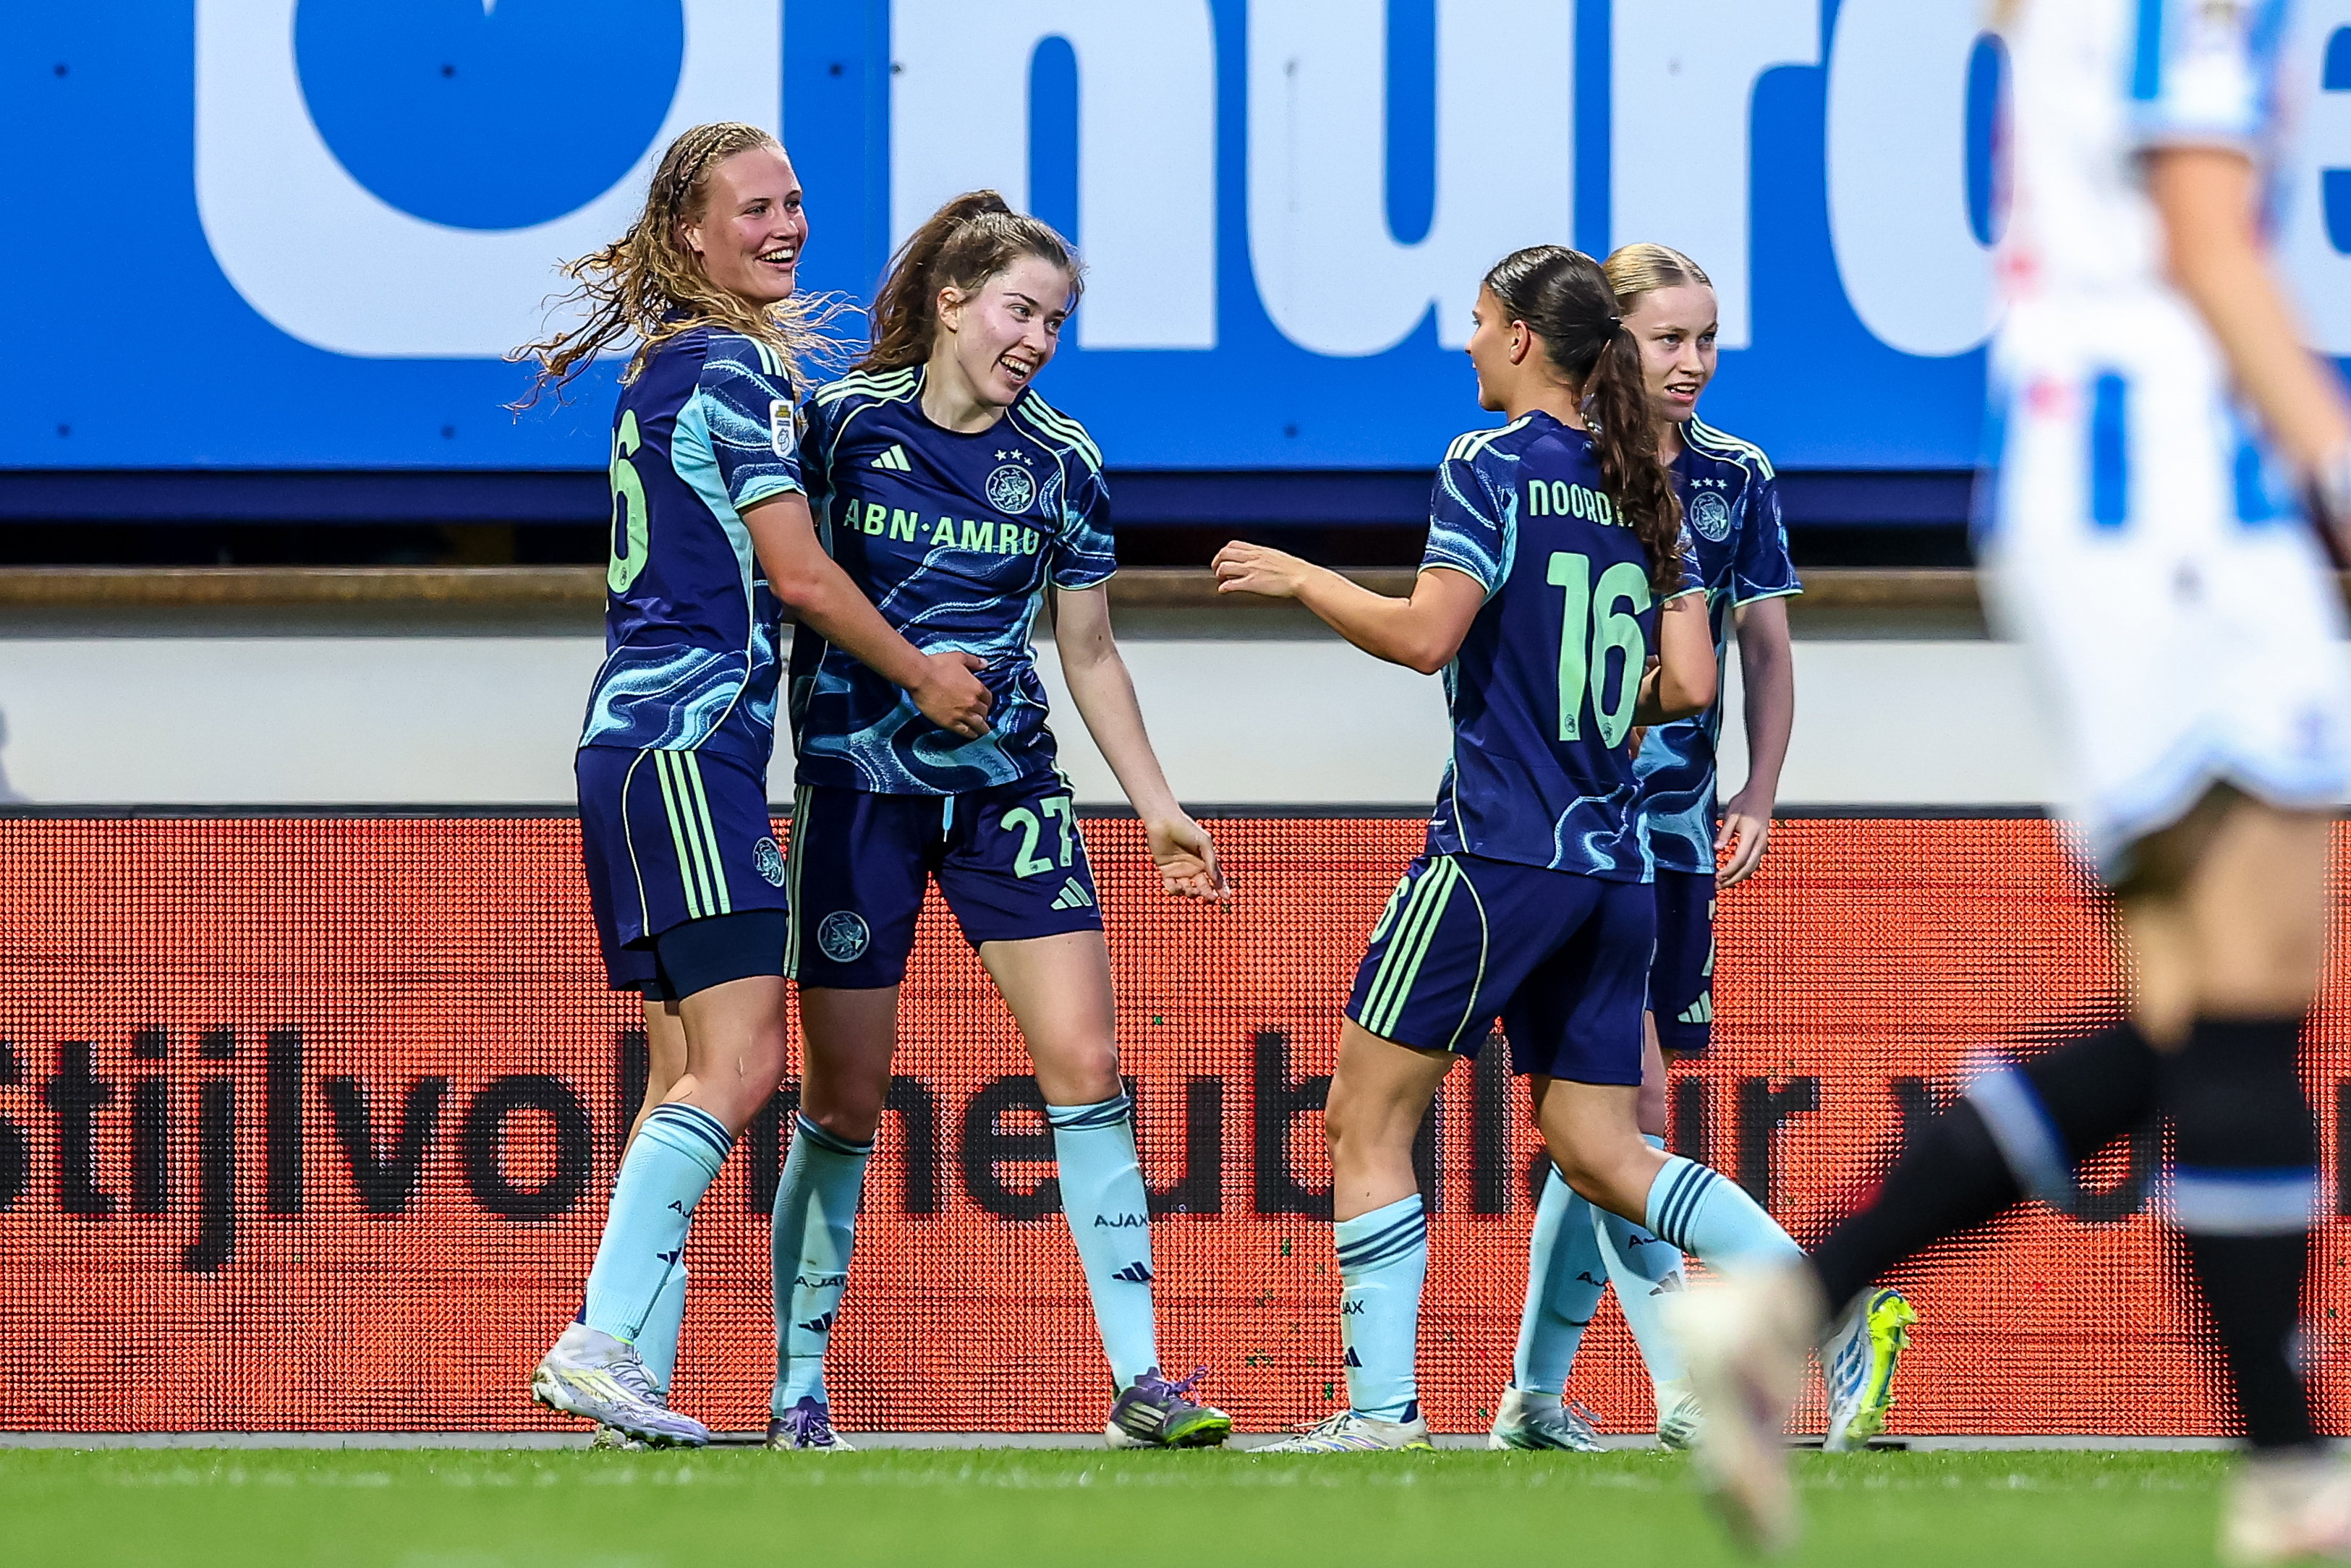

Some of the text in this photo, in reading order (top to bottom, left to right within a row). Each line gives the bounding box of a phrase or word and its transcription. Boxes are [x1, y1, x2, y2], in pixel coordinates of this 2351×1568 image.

[890, 0, 2351, 357] nur
[1528, 480, 1634, 527] NOORD
[1547, 551, 1651, 749] 16
[1000, 796, 1073, 879] 27
[1094, 1212, 1149, 1227] AJAX
[1342, 1300, 1364, 1315] AX
